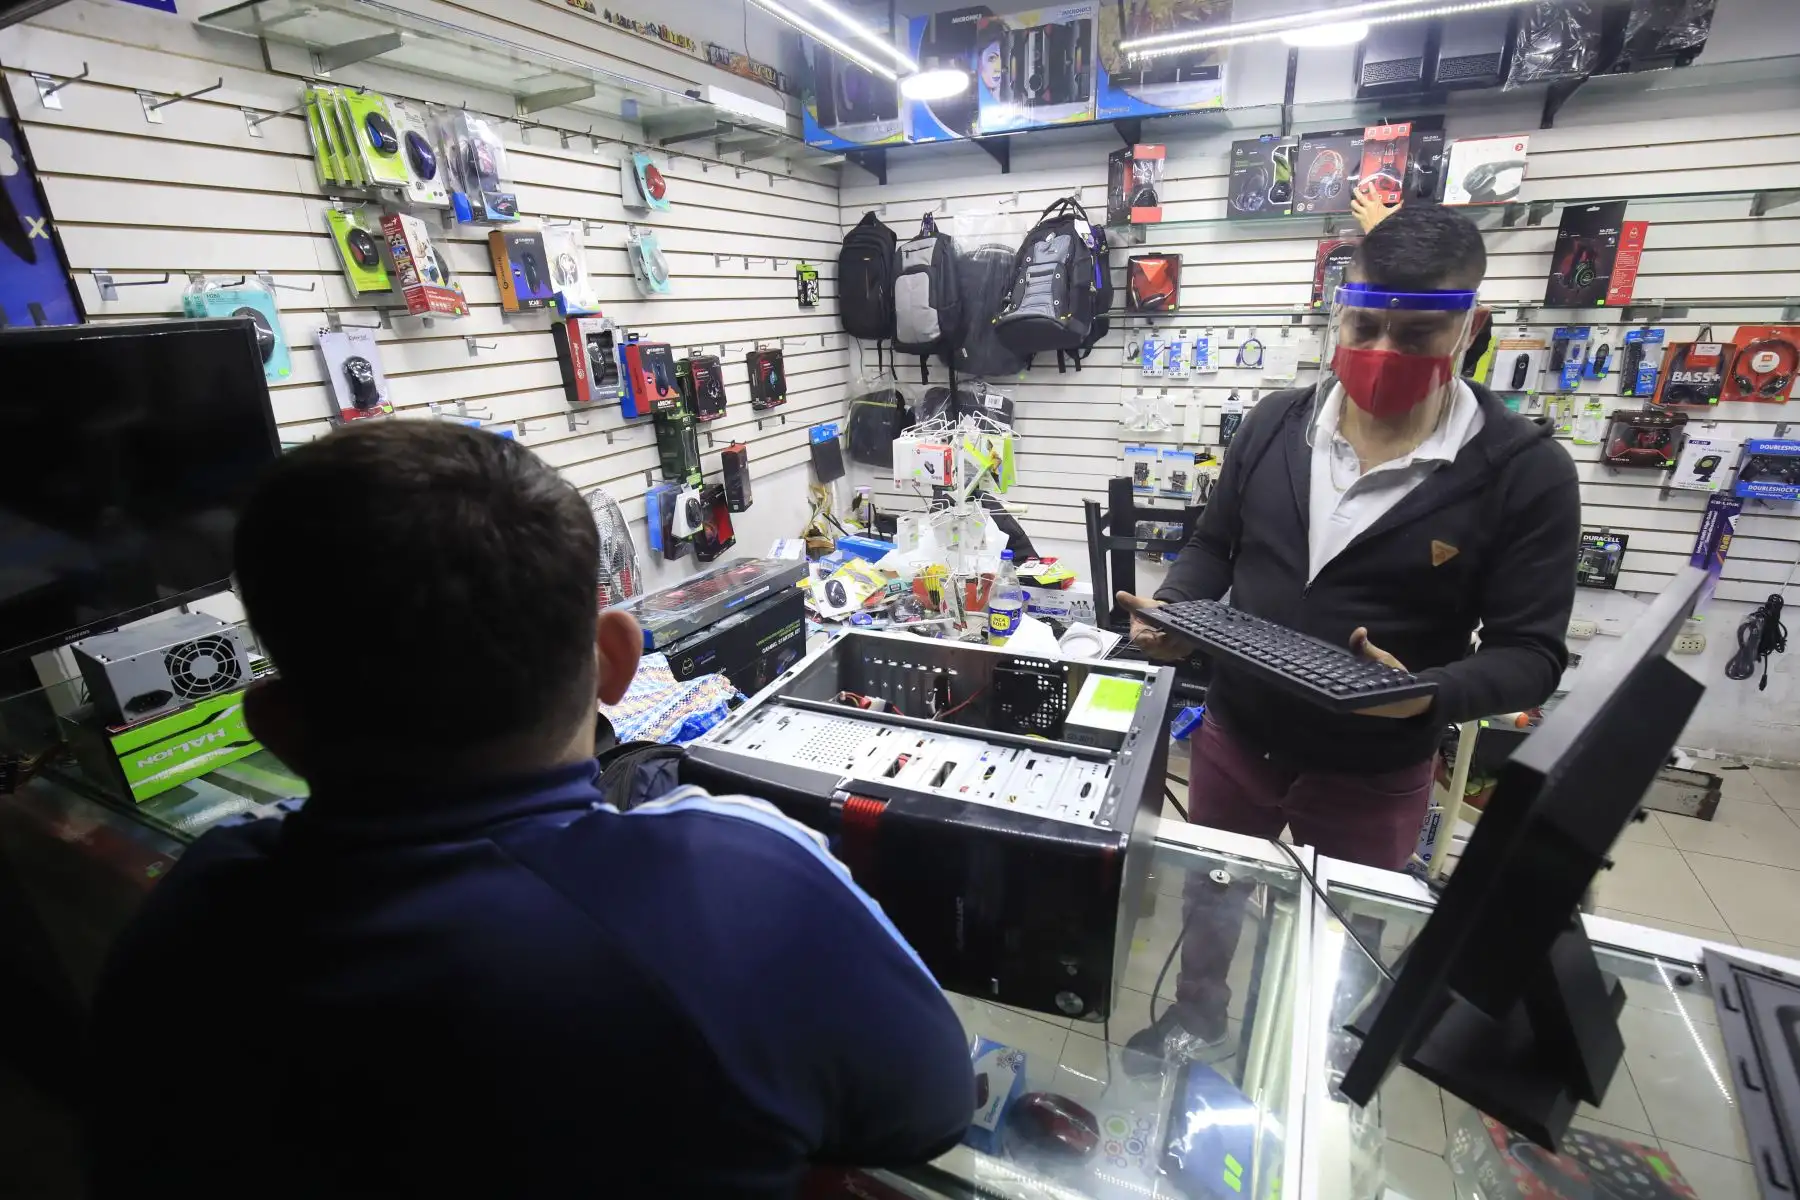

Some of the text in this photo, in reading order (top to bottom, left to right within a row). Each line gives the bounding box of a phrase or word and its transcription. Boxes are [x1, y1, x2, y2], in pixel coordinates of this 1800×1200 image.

[952, 13, 982, 24] MICRONICS
[1671, 371, 1720, 382] BASS+
[1583, 534, 1620, 543] DURACELL
[137, 728, 226, 768] HALION
